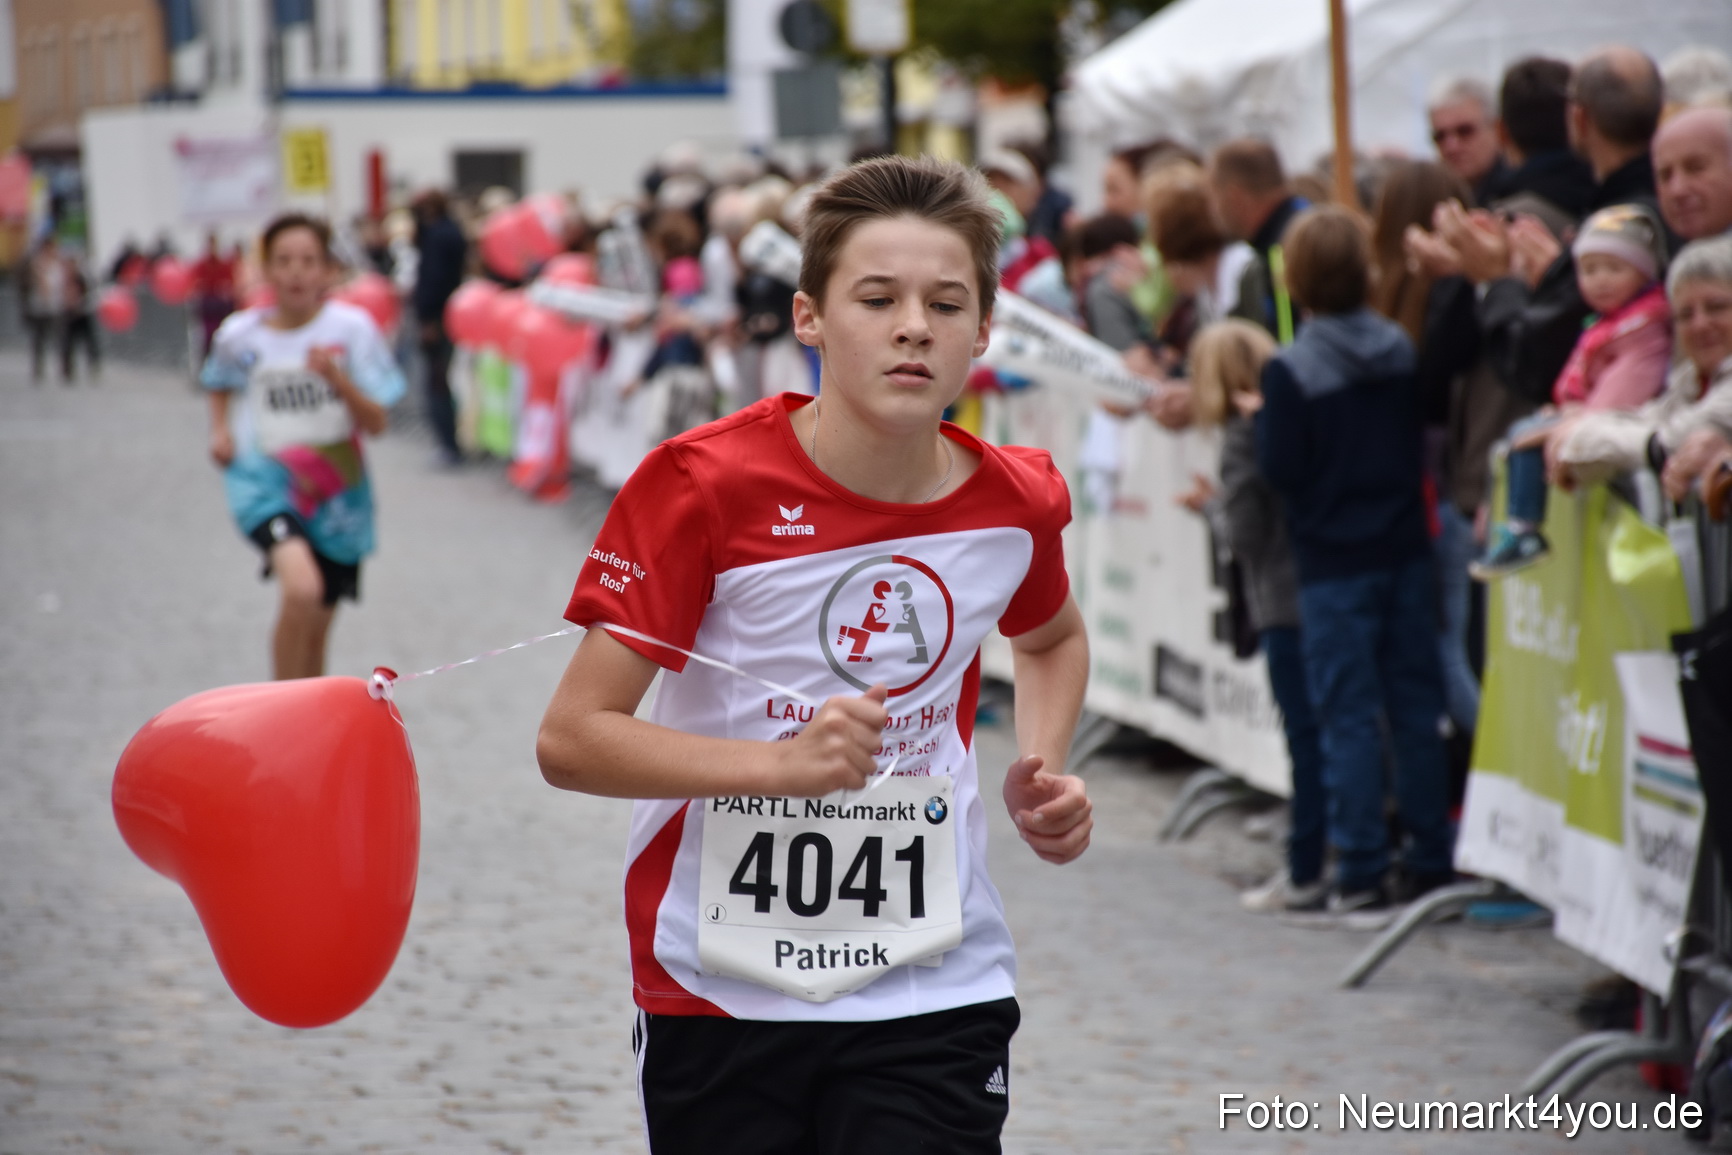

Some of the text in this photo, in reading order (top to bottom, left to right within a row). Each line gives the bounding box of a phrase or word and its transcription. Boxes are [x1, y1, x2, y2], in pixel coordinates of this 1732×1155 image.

[771, 523, 815, 536] erima
[589, 545, 646, 580] Laufen für
[599, 572, 626, 594] Rosi
[712, 796, 797, 818] PARTL
[804, 798, 916, 821] Neumarkt
[729, 831, 926, 919] 4041
[775, 940, 890, 971] Patrick
